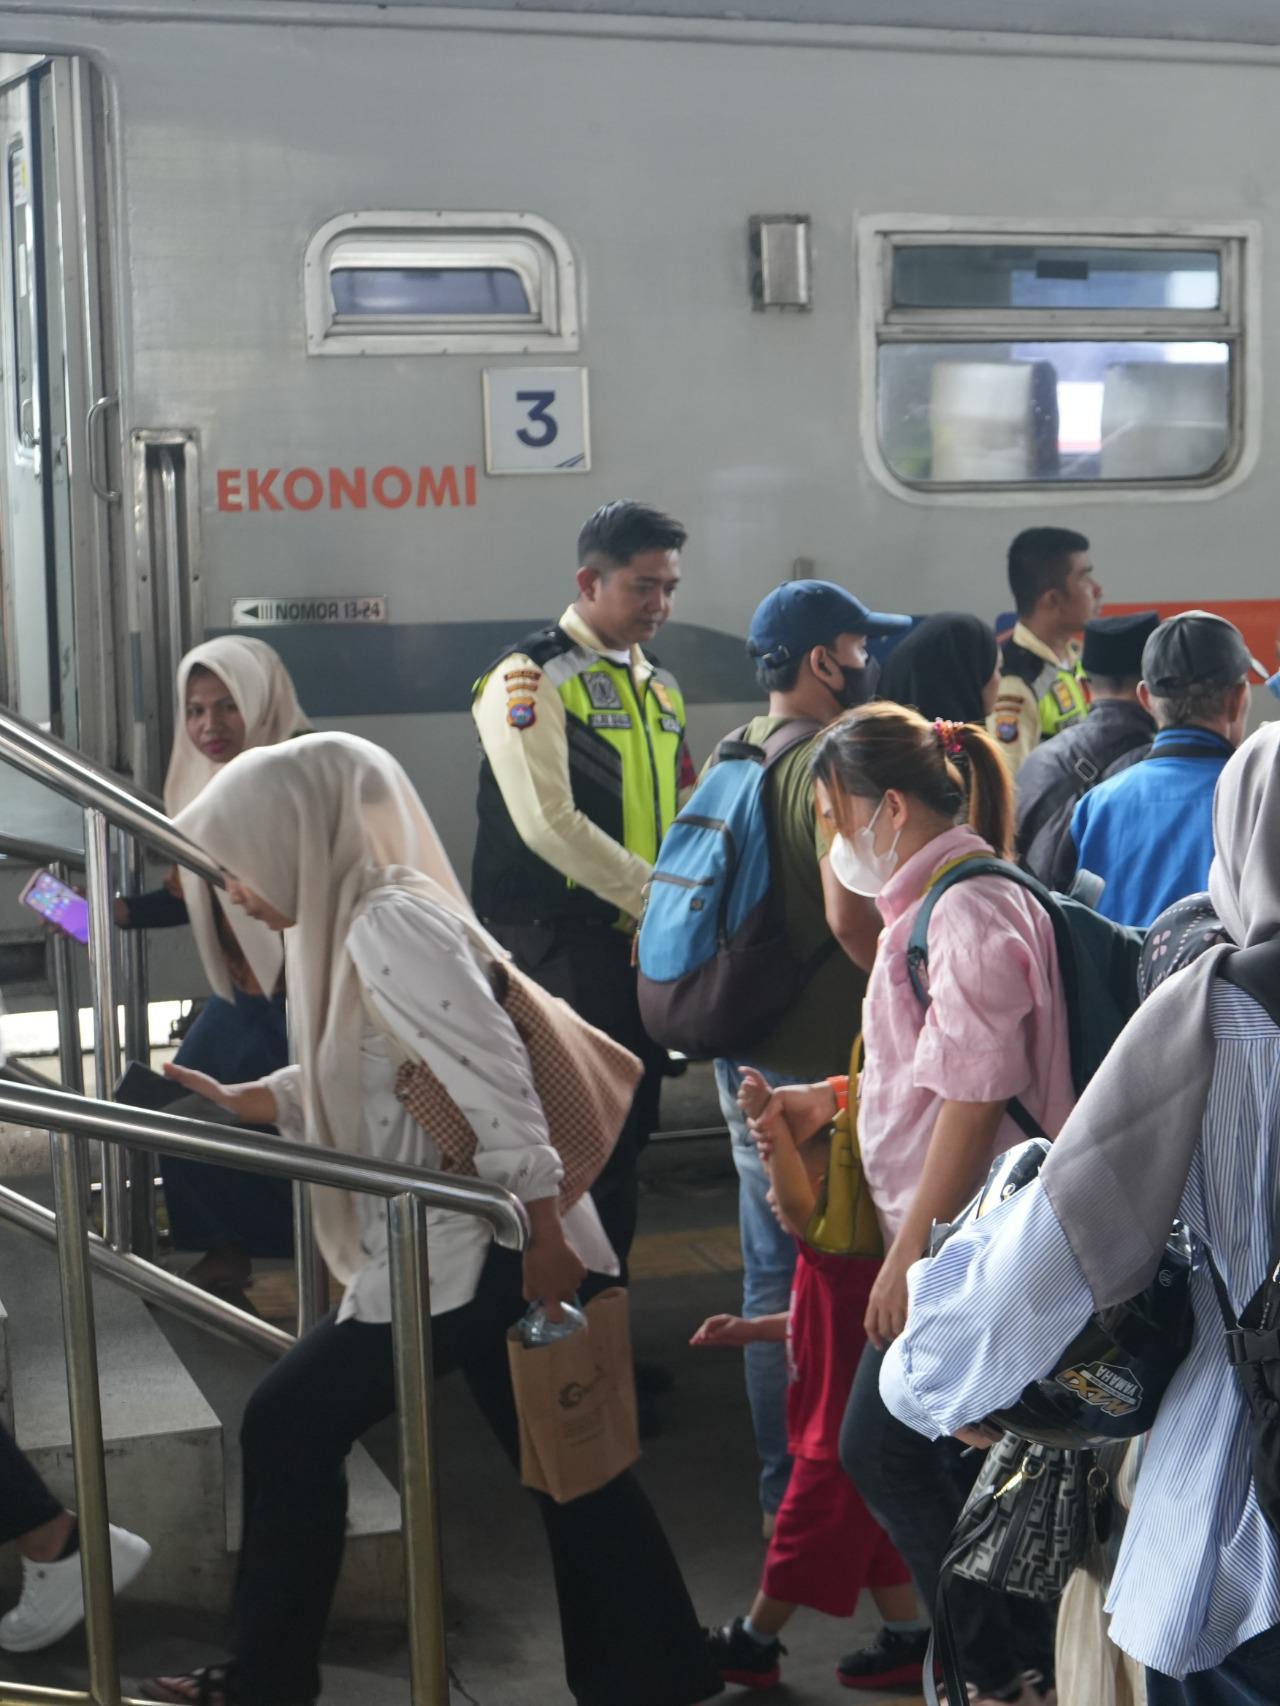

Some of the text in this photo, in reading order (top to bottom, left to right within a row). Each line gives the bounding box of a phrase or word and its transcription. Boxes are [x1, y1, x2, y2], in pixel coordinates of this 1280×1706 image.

[516, 390, 558, 448] 3
[217, 465, 477, 512] EKONOMI
[275, 601, 380, 619] NOMOR 13-24
[1095, 1365, 1138, 1397] YAMAHA
